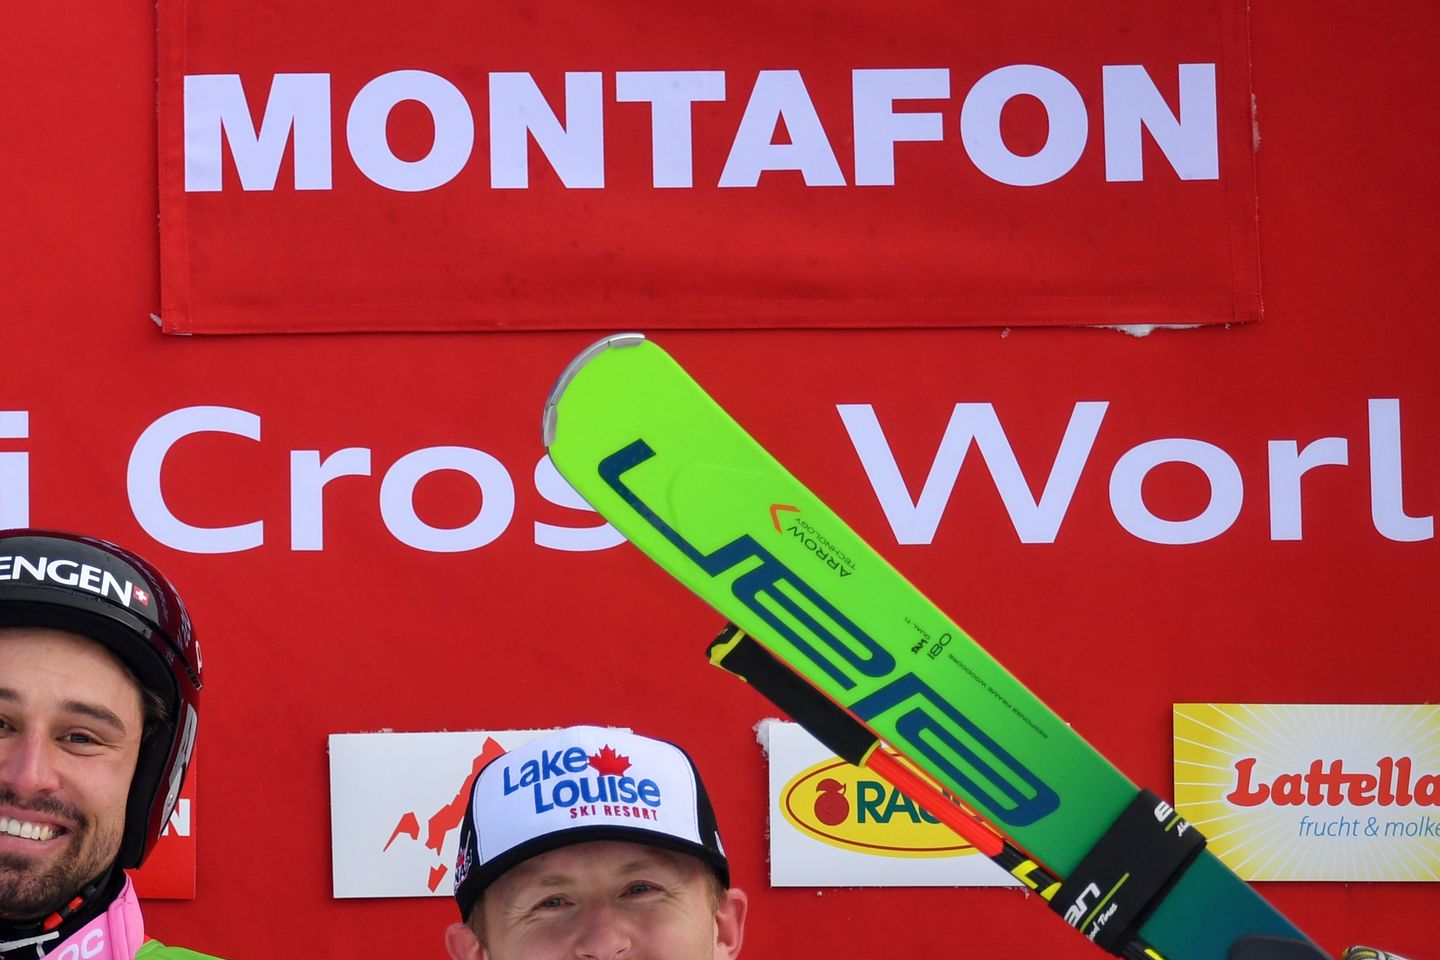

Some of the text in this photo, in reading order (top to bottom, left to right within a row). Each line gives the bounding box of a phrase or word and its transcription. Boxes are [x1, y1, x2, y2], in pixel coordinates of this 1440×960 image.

[184, 63, 1220, 193] MONTAFON
[125, 405, 631, 554] Cros
[836, 398, 1437, 546] Worl
[787, 525, 851, 577] ARROW
[794, 517, 856, 571] TECHNOLOGY
[927, 633, 952, 660] 180
[503, 746, 590, 796] Lake
[533, 775, 661, 814] Louise
[1226, 756, 1440, 807] Lattella
[570, 804, 659, 822] SKI RESORT
[1299, 815, 1440, 838] frucht & molke
